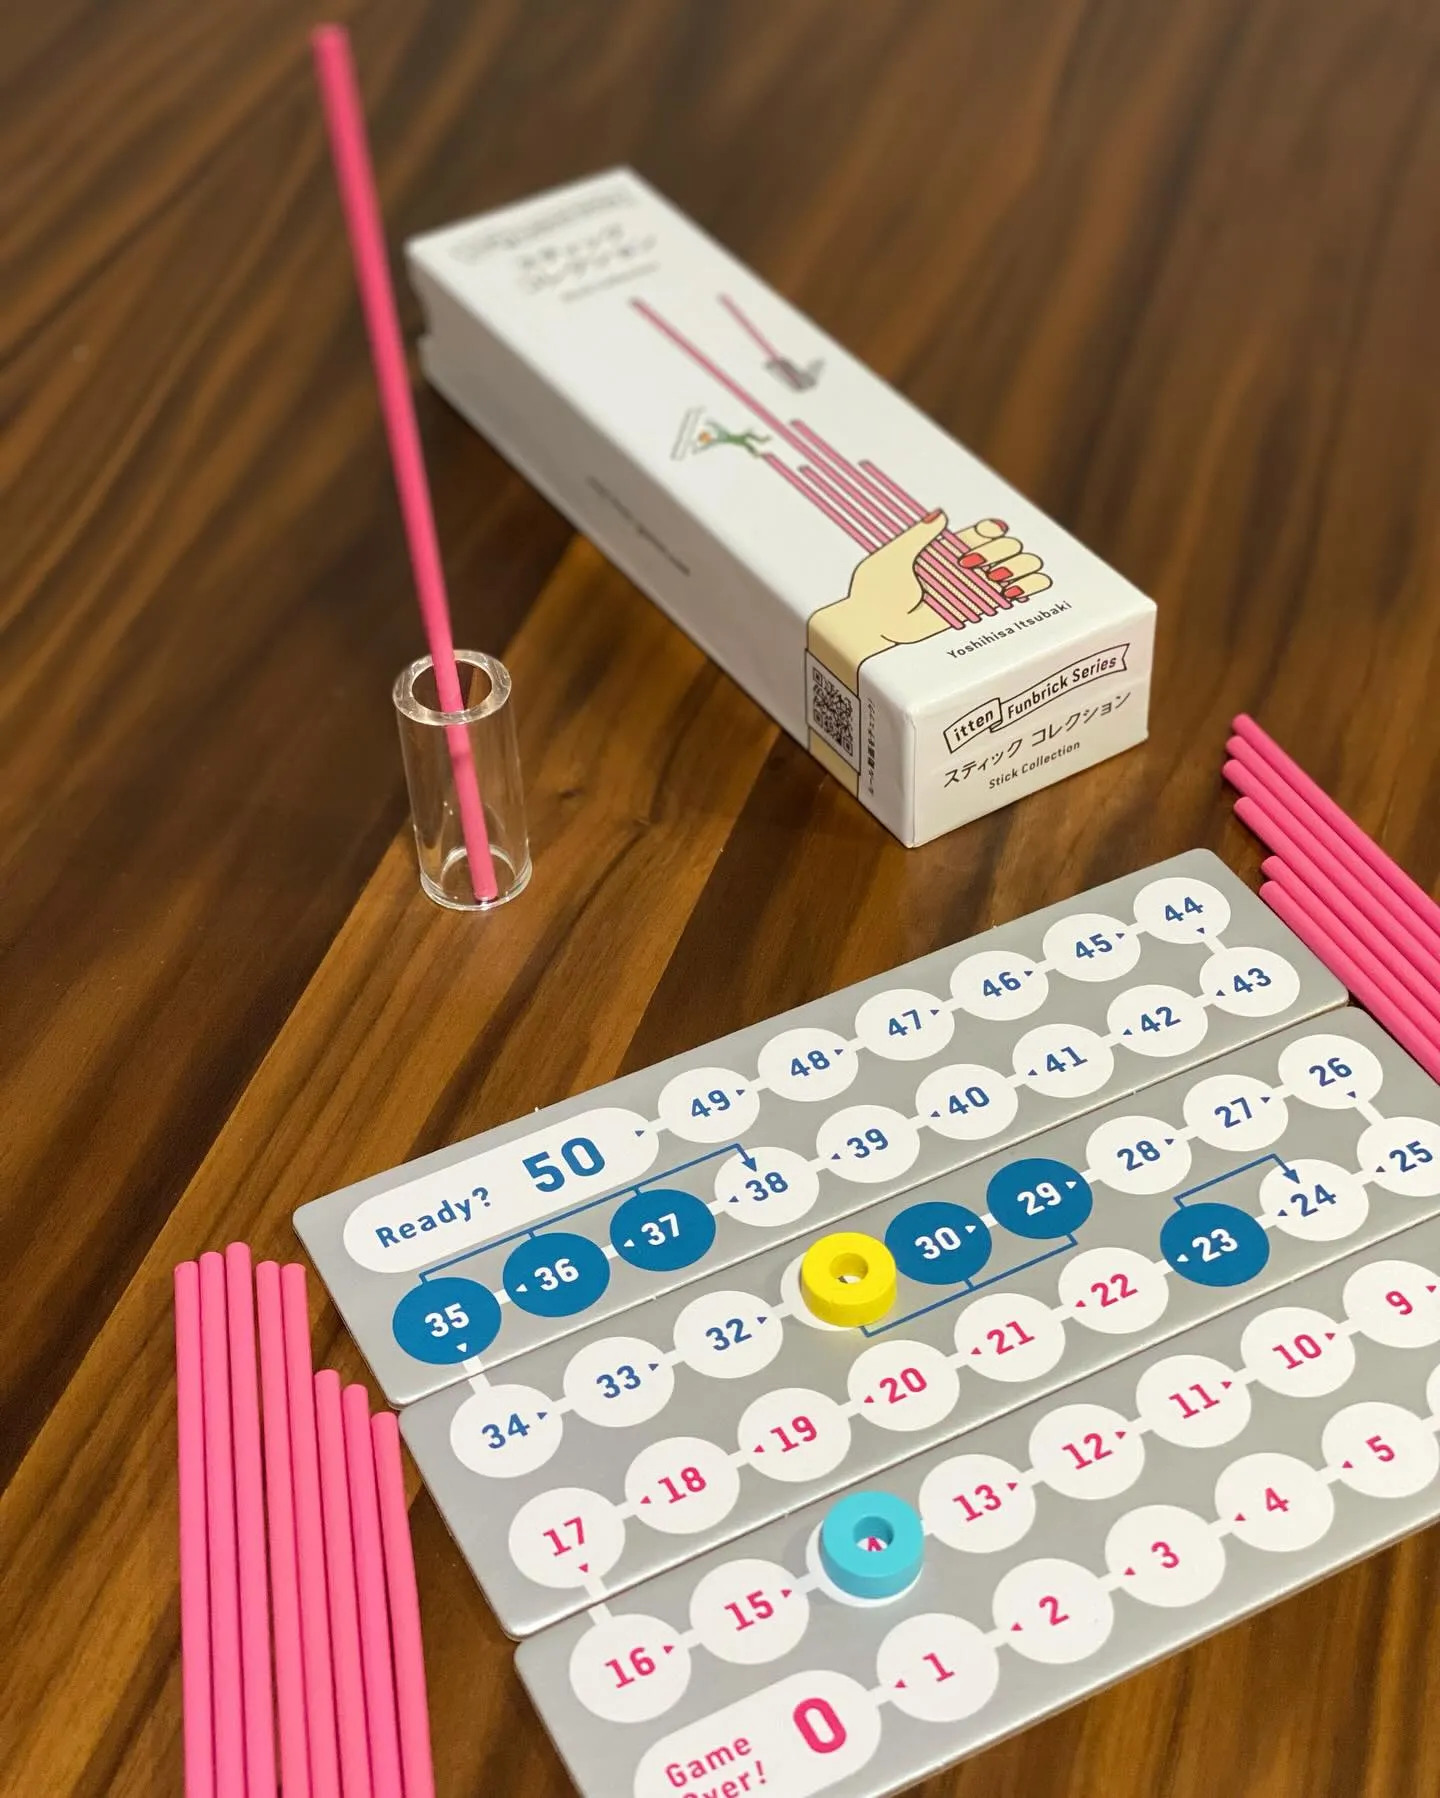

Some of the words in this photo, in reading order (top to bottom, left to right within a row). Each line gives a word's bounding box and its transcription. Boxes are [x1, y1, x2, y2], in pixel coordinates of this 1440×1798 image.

[947, 627, 1015, 659] Yoshihisa
[1015, 600, 1072, 630] Itsubaki
[1008, 676, 1068, 719] Funbrick
[1072, 656, 1117, 682] Series
[944, 739, 1023, 787] スティック
[1031, 692, 1131, 747] コレクション
[953, 709, 993, 741] itten
[989, 768, 1018, 789] Stick
[1022, 741, 1080, 773] Collection
[1164, 897, 1203, 922] 44
[1075, 934, 1111, 959] 45
[983, 973, 1020, 997] 46
[1233, 968, 1270, 993] 43
[888, 1009, 922, 1037] 47
[1141, 1007, 1180, 1033] 42
[790, 1050, 829, 1077] 48
[1046, 1047, 1086, 1072] 41
[1310, 1058, 1351, 1085] 26
[690, 1089, 730, 1117] 49
[948, 1088, 989, 1115] 40
[1215, 1099, 1252, 1128] 27
[847, 1128, 888, 1157] 39
[1118, 1141, 1160, 1171] 28
[1390, 1142, 1433, 1171] 25
[375, 1186, 490, 1249] Ready?
[522, 1137, 604, 1192] 50
[745, 1173, 787, 1202] 38
[1018, 1183, 1061, 1216] 29
[1291, 1185, 1335, 1217] 24
[641, 1213, 681, 1245] 37
[915, 1227, 961, 1260] 30
[1192, 1229, 1237, 1263] 23
[534, 1259, 579, 1290] 36
[1091, 1274, 1137, 1307] 22
[1386, 1291, 1412, 1315] 9
[425, 1303, 469, 1337] 35
[706, 1318, 750, 1350] 32
[987, 1321, 1034, 1354] 21
[1273, 1334, 1321, 1369] 10
[597, 1366, 640, 1397] 33
[880, 1368, 927, 1403] 20
[1170, 1384, 1218, 1419] 11
[482, 1414, 529, 1448] 34
[771, 1416, 816, 1452] 19
[1063, 1433, 1112, 1469] 12
[1366, 1436, 1395, 1462] 5
[658, 1467, 706, 1504] 18
[1266, 1488, 1288, 1512] 4
[954, 1484, 1001, 1521] 13
[544, 1517, 586, 1556] 17
[1152, 1542, 1179, 1568] 3
[725, 1591, 773, 1630] 15
[1039, 1596, 1068, 1625] 2
[605, 1648, 656, 1688] 16
[924, 1653, 953, 1681] 1
[793, 1698, 847, 1754] 0
[665, 1737, 752, 1788] Game
